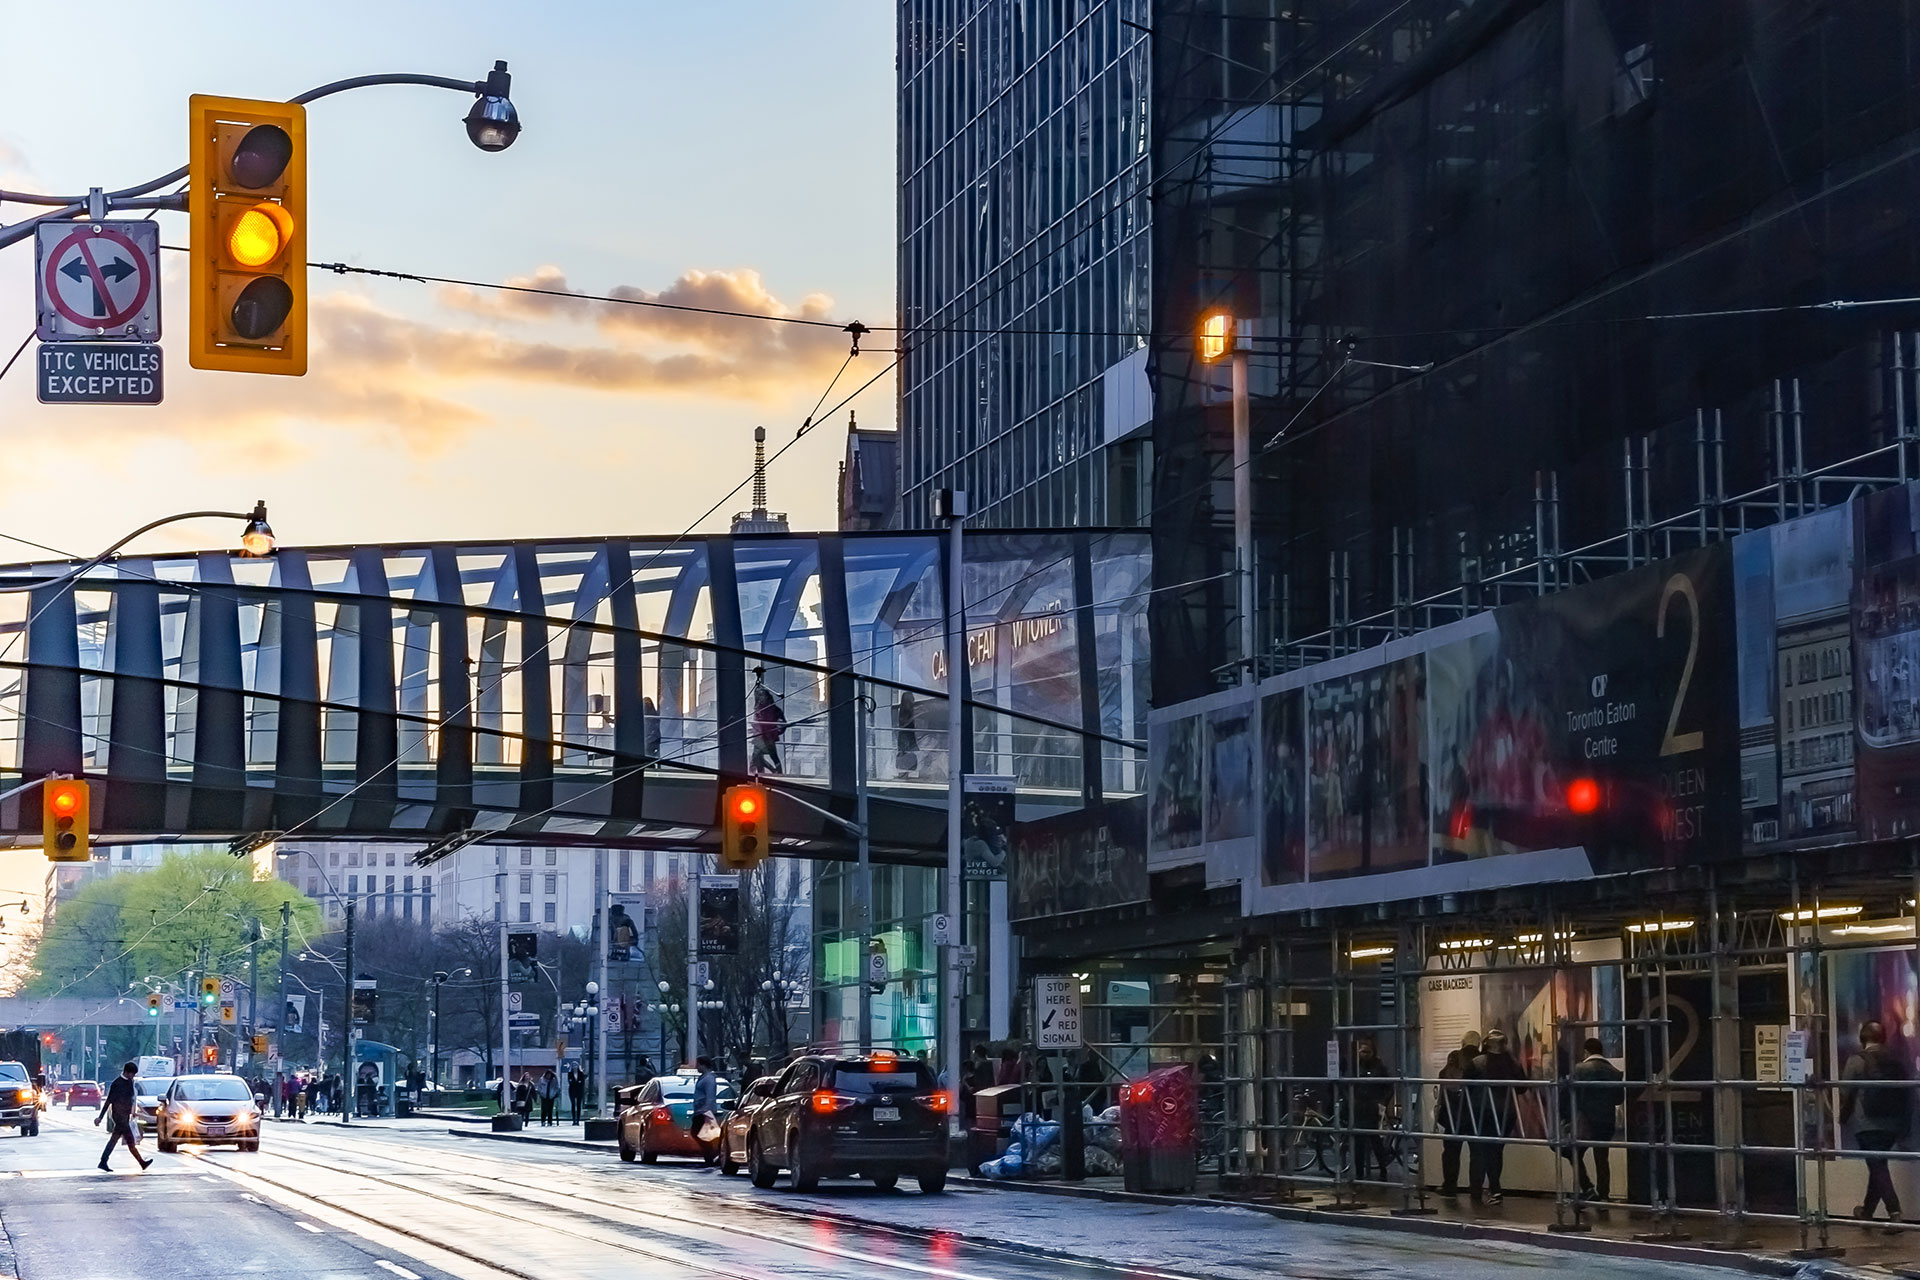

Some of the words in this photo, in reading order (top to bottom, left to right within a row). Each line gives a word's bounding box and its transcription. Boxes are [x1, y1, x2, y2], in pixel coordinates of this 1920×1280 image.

[42, 352, 75, 370] TTC
[83, 353, 159, 371] VEHICLES
[48, 376, 154, 395] EXCEPTED
[1656, 572, 1704, 757] 2
[1566, 705, 1604, 733] Toronto
[1606, 700, 1636, 726] Eaton
[1584, 736, 1618, 759] Centre
[1659, 767, 1705, 799] QUEEN
[1657, 804, 1705, 842] WEST
[966, 868, 998, 876] YONGE
[1047, 982, 1071, 992] STOP
[1046, 995, 1072, 1005] HERE
[1064, 1008, 1077, 1017] ON
[1058, 1021, 1077, 1030] RED
[1043, 1033, 1077, 1043] SIGNAL
